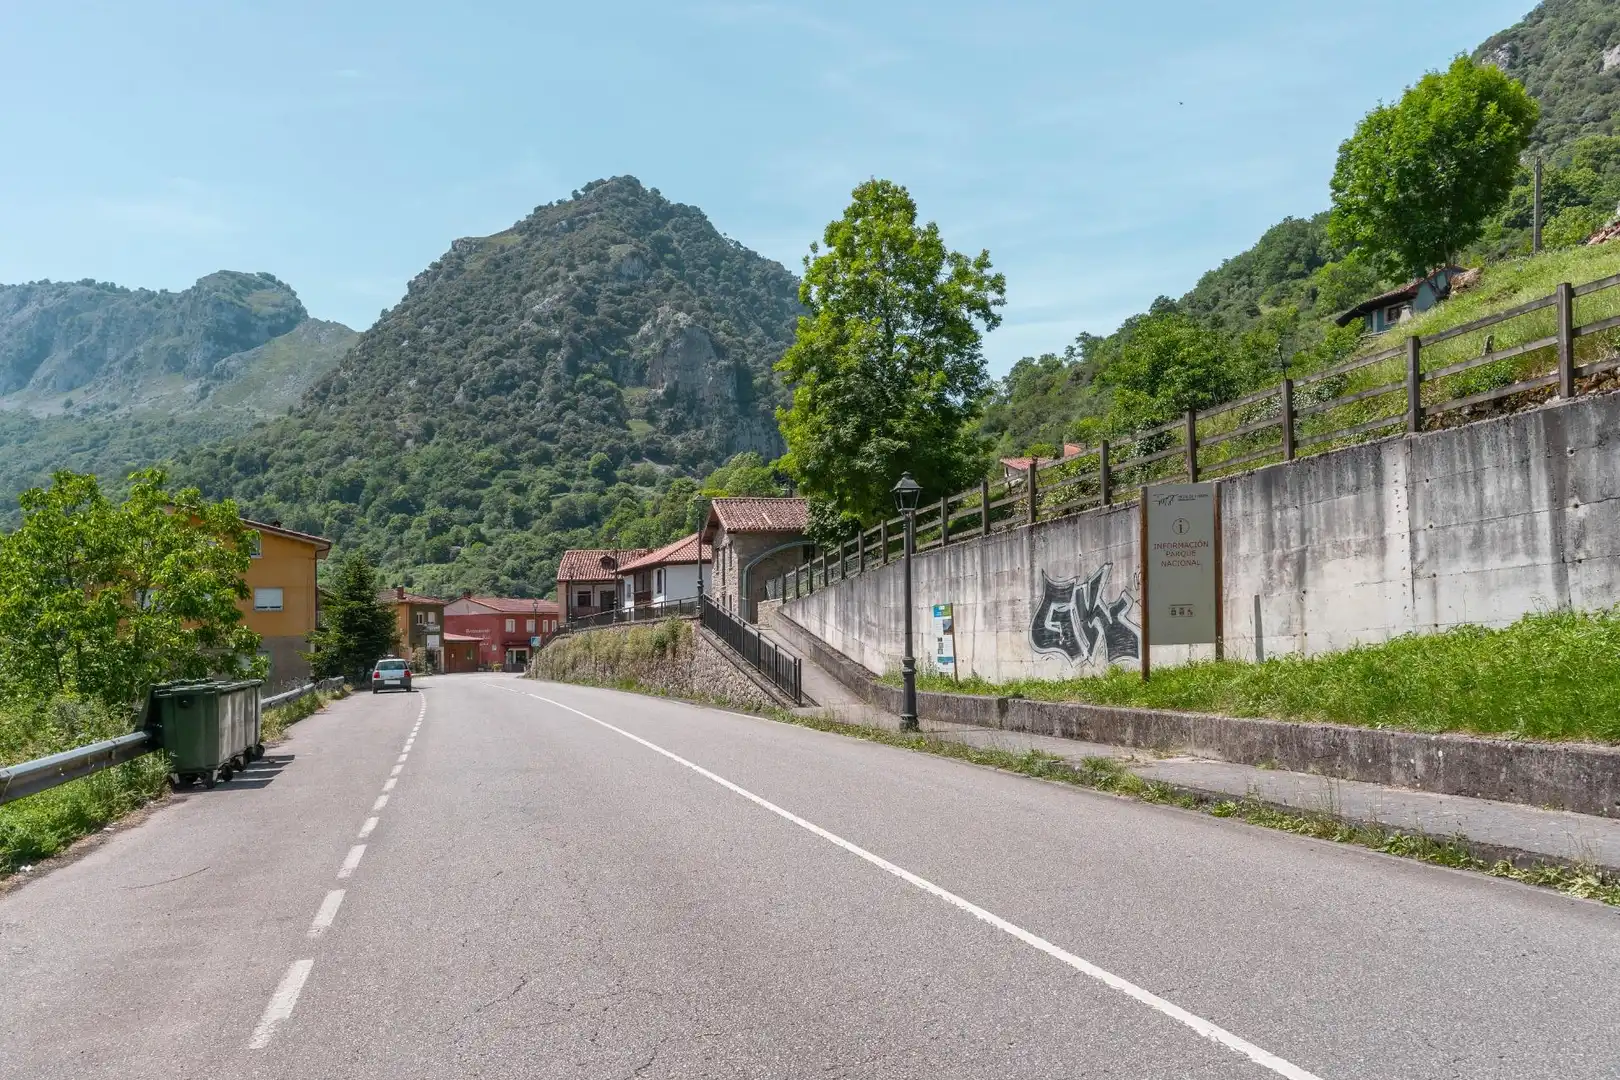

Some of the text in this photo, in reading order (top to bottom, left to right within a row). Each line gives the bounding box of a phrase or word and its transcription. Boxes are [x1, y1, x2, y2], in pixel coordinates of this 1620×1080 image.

[1153, 540, 1209, 550] INFORMACIÓN
[1165, 550, 1197, 558] PARQUE
[1160, 560, 1201, 568] NACIONAL
